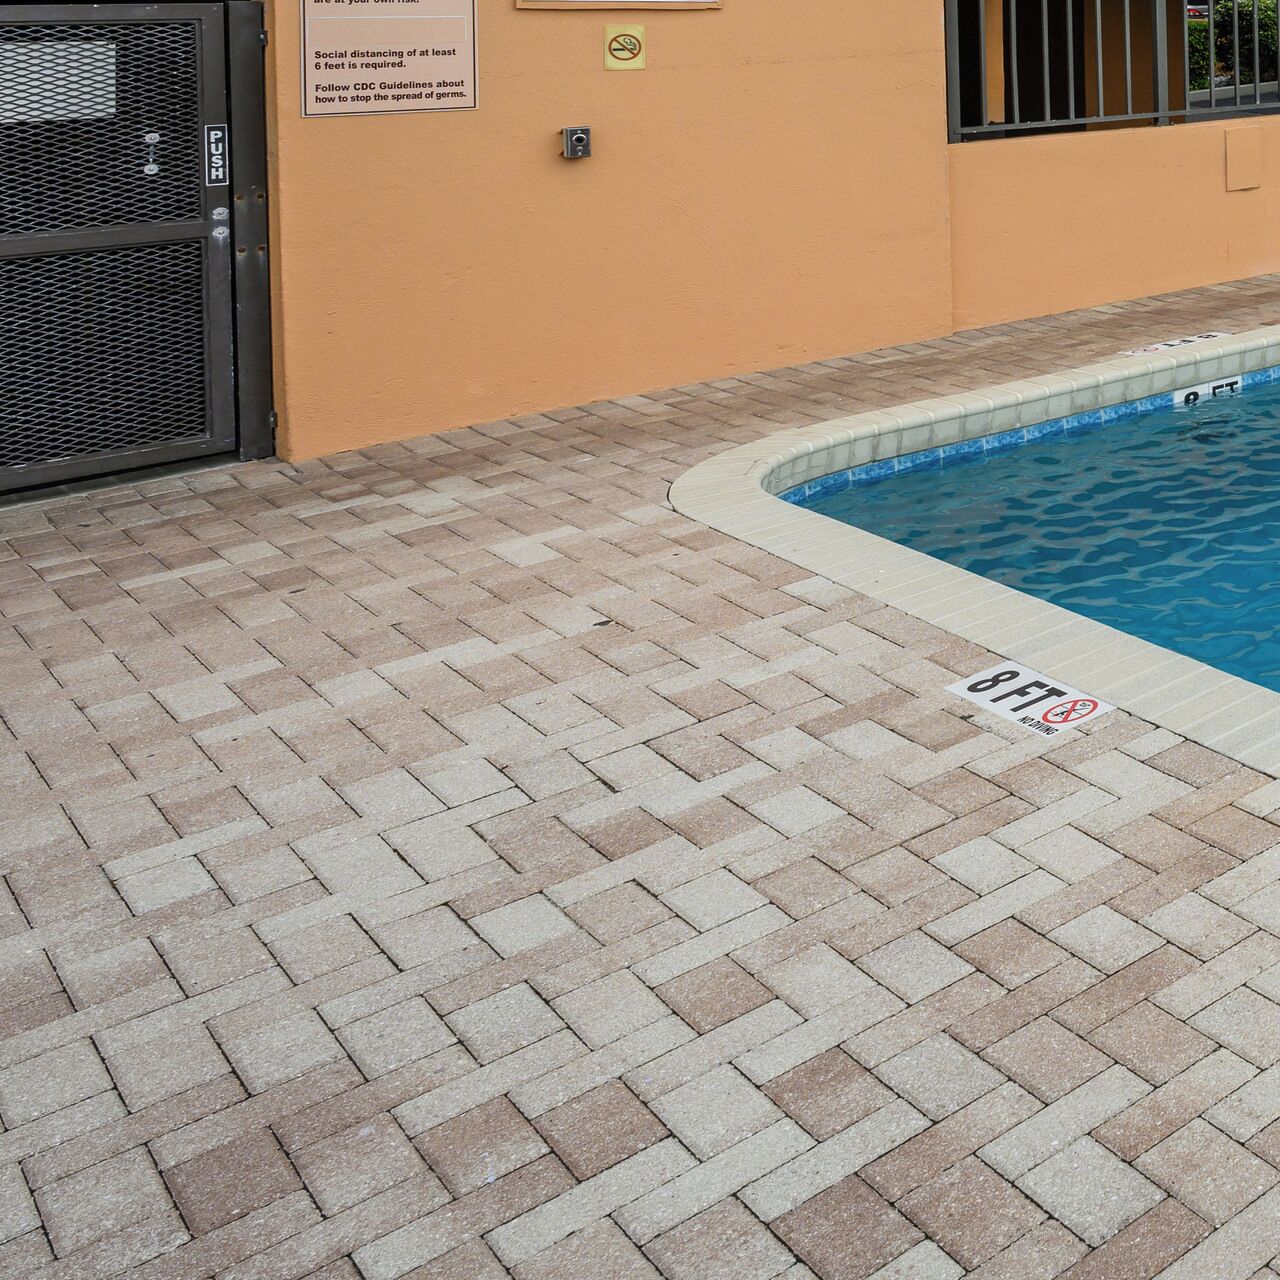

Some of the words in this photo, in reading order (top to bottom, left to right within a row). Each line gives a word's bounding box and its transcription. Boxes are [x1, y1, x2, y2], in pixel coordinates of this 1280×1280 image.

[314, 50, 347, 59] Social
[350, 49, 404, 58] distancing
[432, 48, 456, 56] least
[314, 62, 321, 70] 6
[325, 61, 345, 69] feet
[348, 61, 357, 69] is
[361, 60, 406, 70] required.
[315, 84, 350, 92] Follow
[353, 82, 376, 90] CDC
[379, 81, 433, 90] Guidelines
[436, 80, 464, 88] about
[315, 95, 335, 103] how
[350, 94, 371, 103] stop
[374, 93, 389, 101] the
[391, 91, 422, 101] spread
[425, 91, 434, 99] of
[436, 91, 467, 100] germs.
[210, 131, 223, 179] PUSH
[967, 670, 1020, 693] 8
[989, 680, 1068, 713] FT
[1017, 715, 1035, 724] NO
[1028, 720, 1059, 735] DIVING
